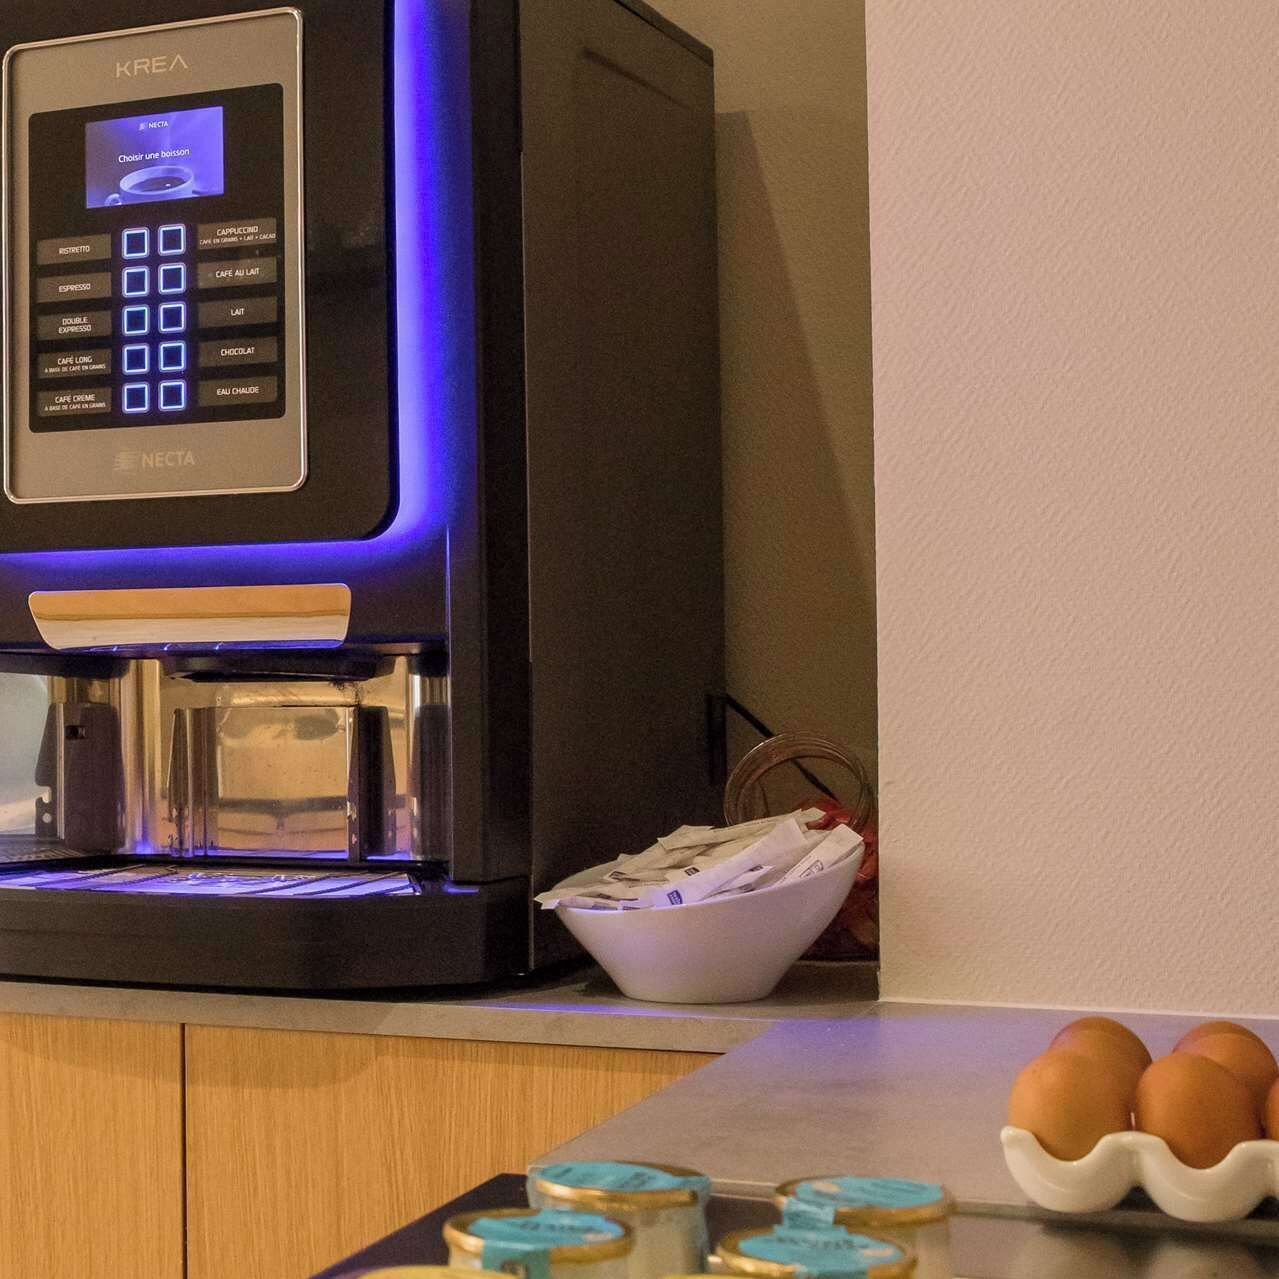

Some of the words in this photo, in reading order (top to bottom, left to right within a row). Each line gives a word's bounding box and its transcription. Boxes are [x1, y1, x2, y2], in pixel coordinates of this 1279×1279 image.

[116, 53, 188, 78] KREA
[148, 121, 168, 129] NECTA
[118, 153, 143, 163] Choisir
[145, 152, 160, 160] une
[161, 148, 190, 158] boisson
[216, 225, 259, 236] CAPPUCCINO
[59, 245, 90, 255] RISTRETTO
[245, 267, 260, 275] LAIT
[59, 283, 91, 293] ESPRESSO
[230, 308, 245, 316] LAIT
[62, 317, 88, 325] DOUBLE
[58, 324, 91, 334] EXPRESSO
[220, 347, 255, 356] CHOCOLAT
[75, 356, 93, 364] LONG
[216, 388, 231, 396] EAU
[231, 386, 260, 395] CHAUDE
[142, 450, 195, 468] NECTA
